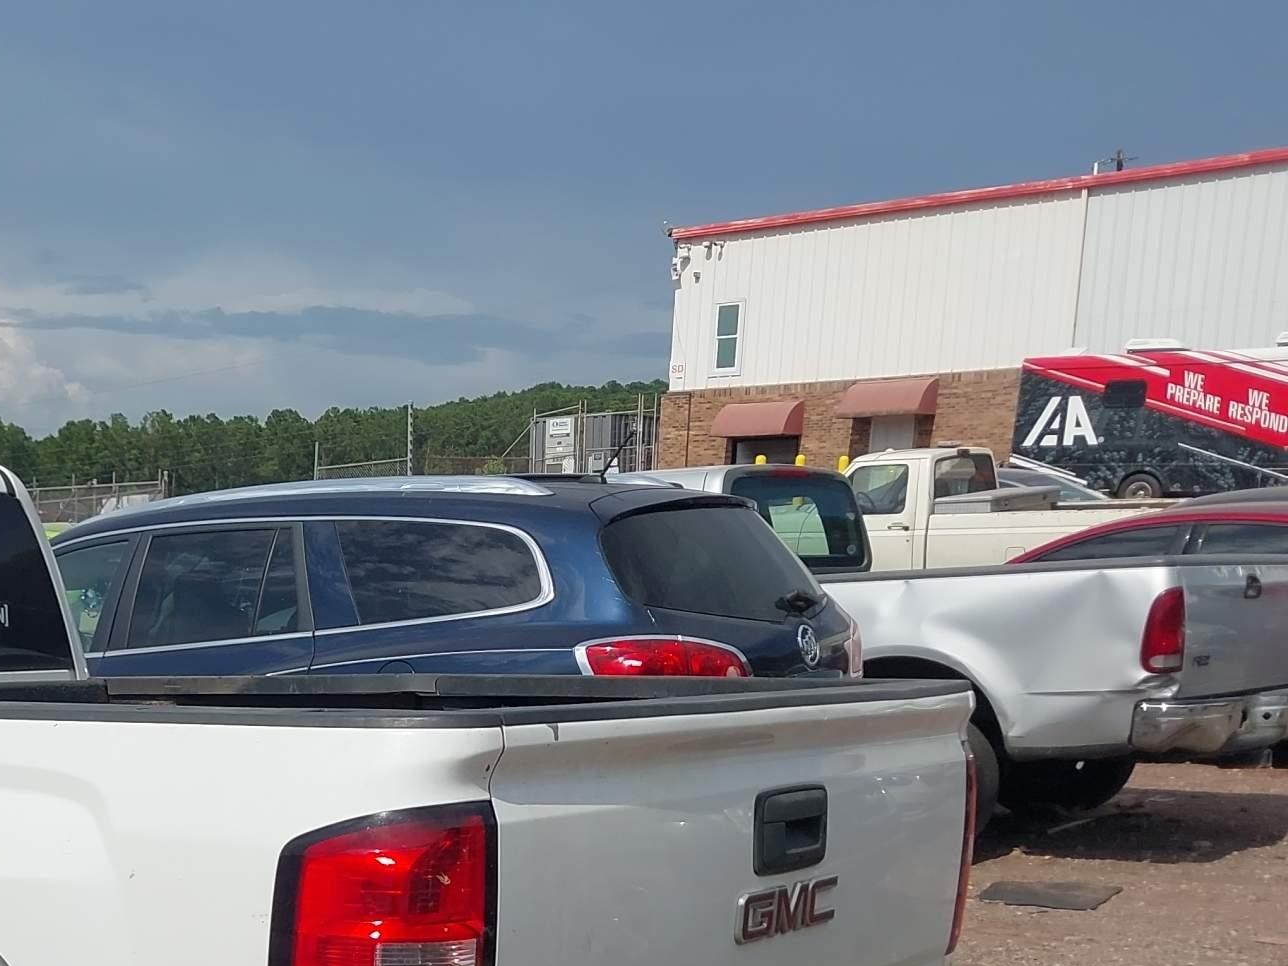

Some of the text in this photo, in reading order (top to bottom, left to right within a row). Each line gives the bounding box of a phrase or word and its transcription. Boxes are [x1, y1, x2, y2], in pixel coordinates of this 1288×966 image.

[1184, 370, 1205, 390] WE
[1167, 383, 1222, 415] PREPARE
[1248, 388, 1270, 410] WE
[1228, 401, 1288, 433] RESPOND
[734, 875, 839, 945] GMC
